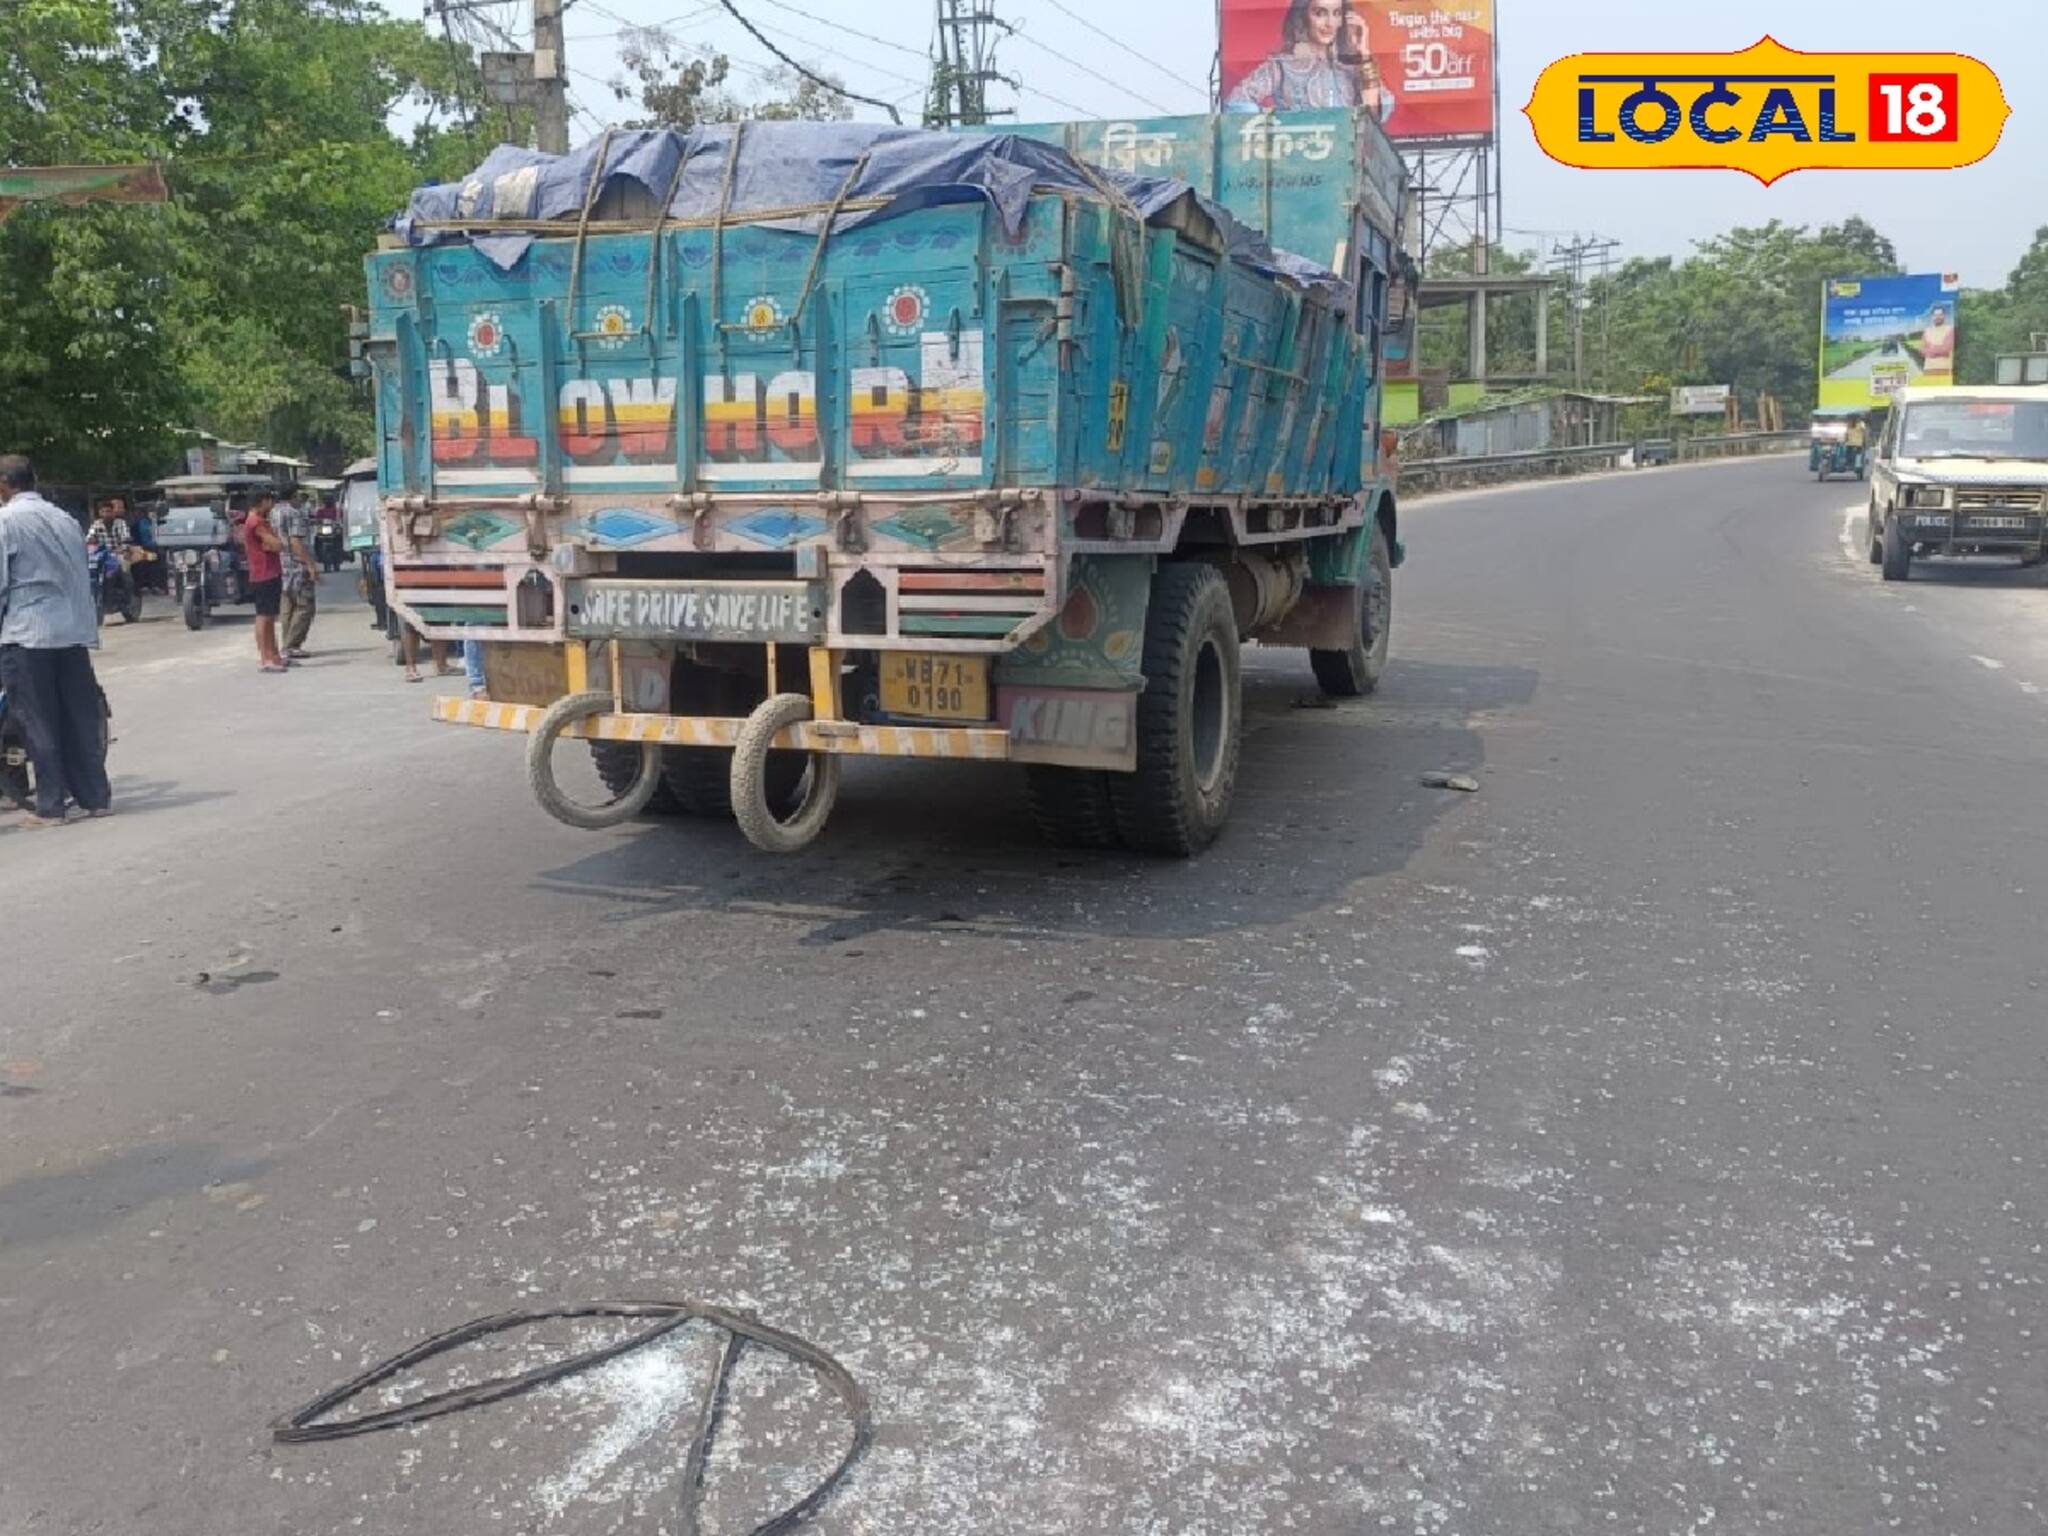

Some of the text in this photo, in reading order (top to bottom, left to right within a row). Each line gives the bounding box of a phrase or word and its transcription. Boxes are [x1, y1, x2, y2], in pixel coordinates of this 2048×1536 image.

[580, 590, 631, 627] SAFE
[702, 593, 755, 631] SAVE
[758, 595, 808, 632] LIFE
